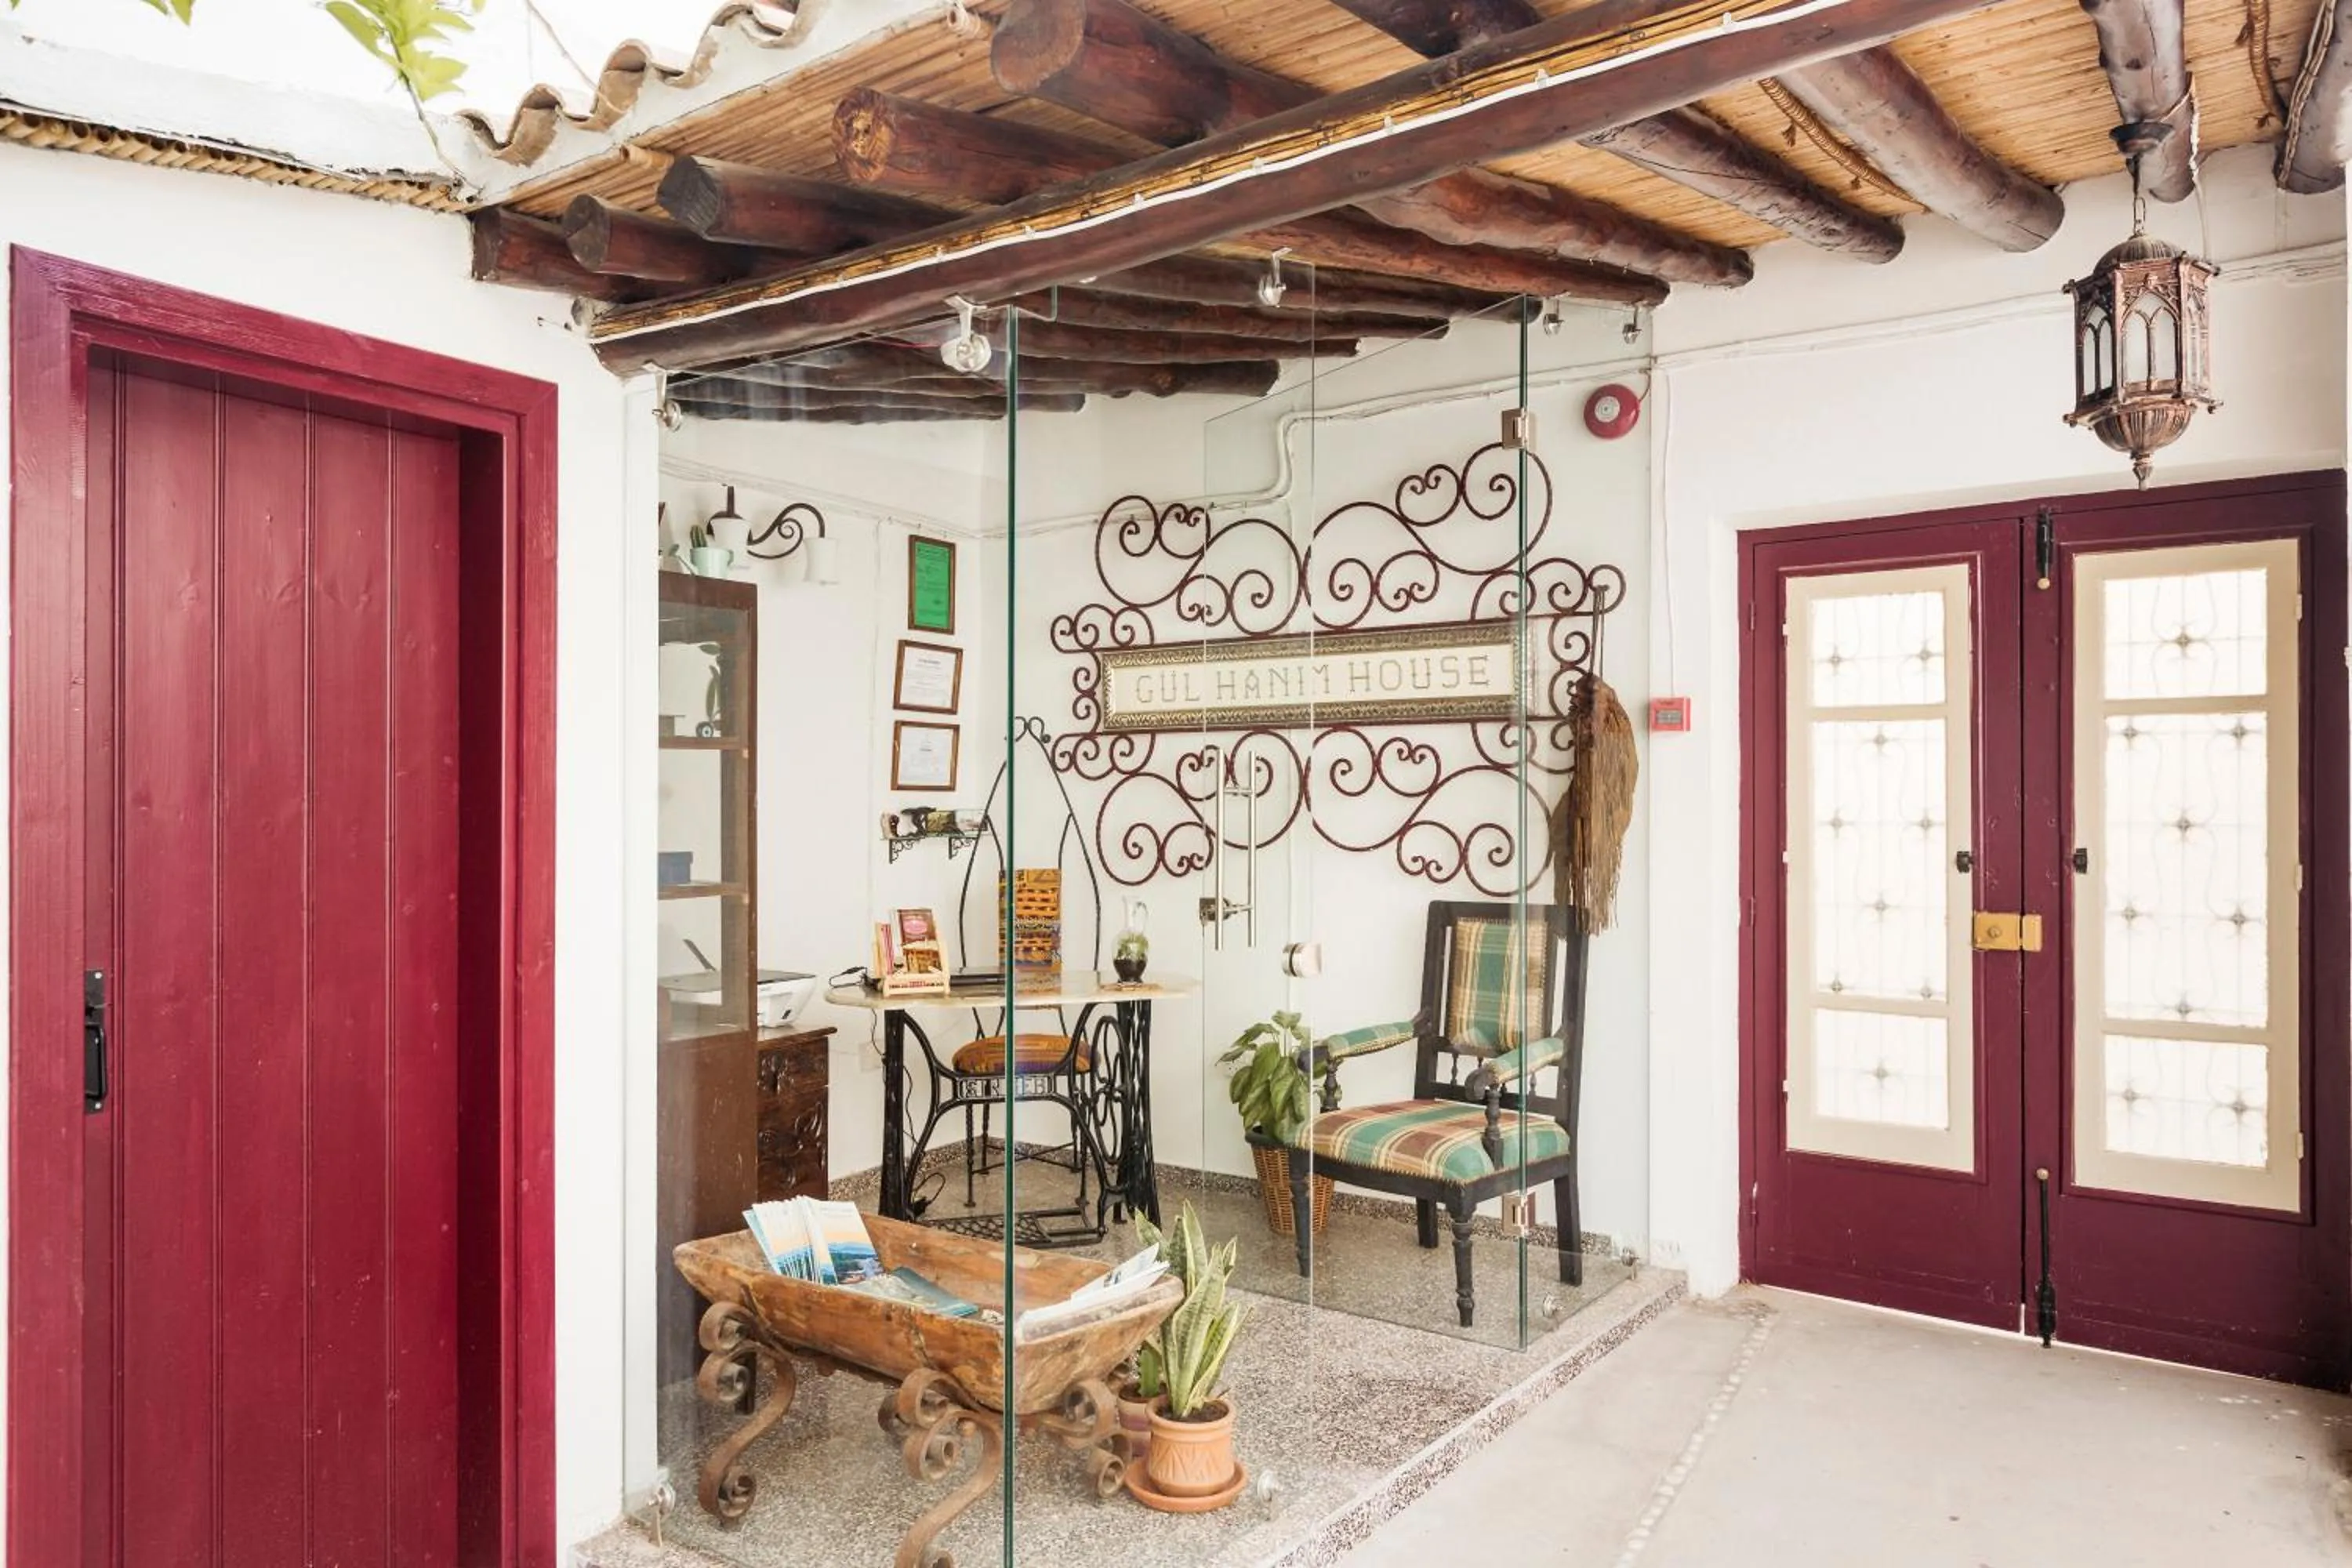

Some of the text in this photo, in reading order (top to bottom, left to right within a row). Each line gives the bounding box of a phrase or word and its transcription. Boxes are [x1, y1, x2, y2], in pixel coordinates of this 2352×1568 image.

[1216, 664, 1330, 699] HANIM
[1348, 655, 1490, 692] HOUSE
[965, 1077, 1046, 1098] SINER
